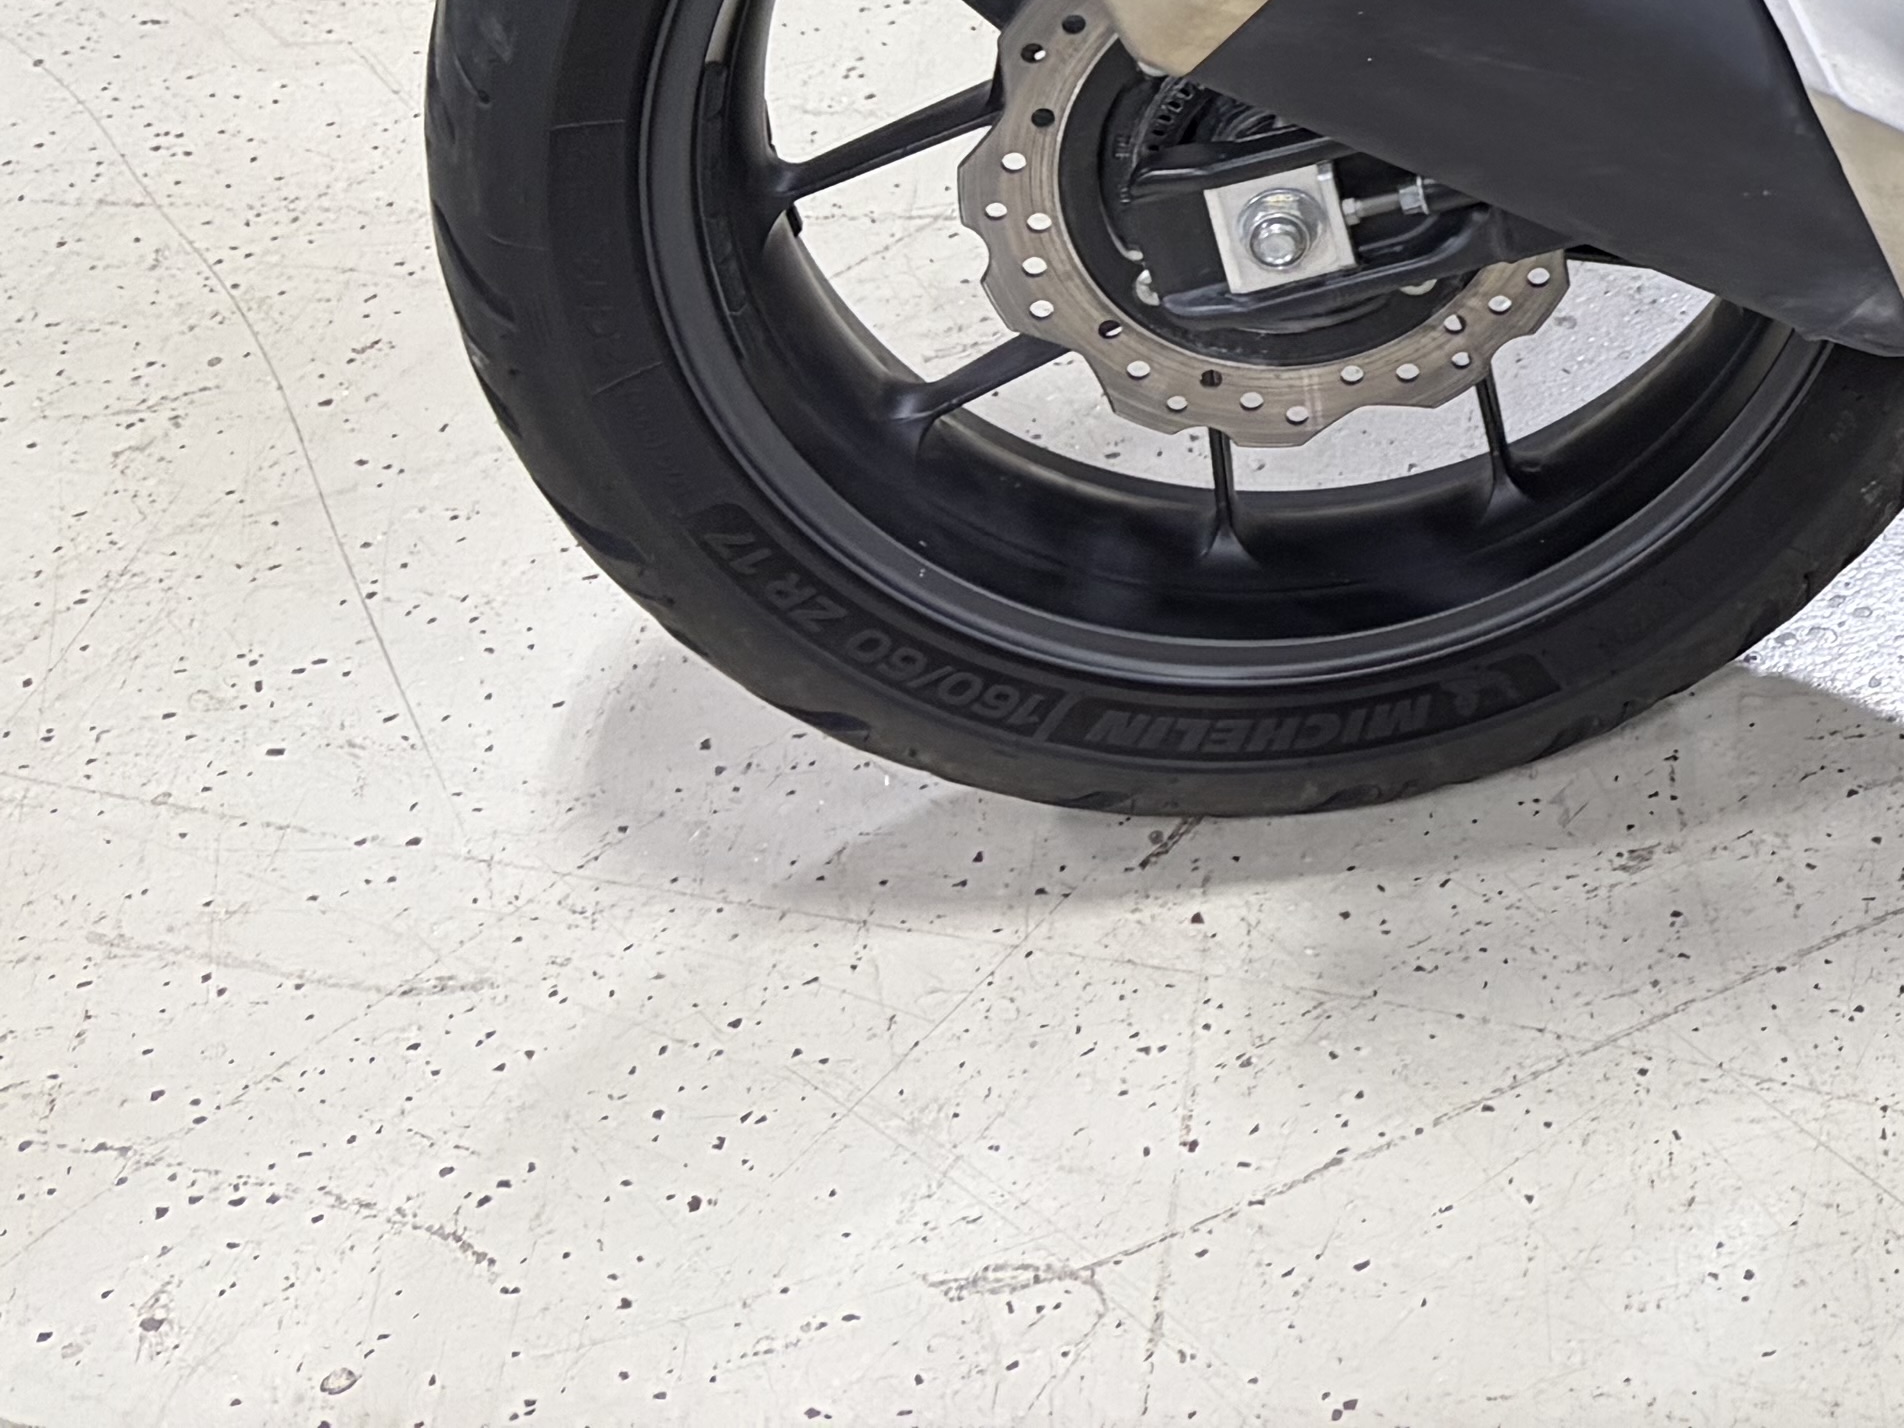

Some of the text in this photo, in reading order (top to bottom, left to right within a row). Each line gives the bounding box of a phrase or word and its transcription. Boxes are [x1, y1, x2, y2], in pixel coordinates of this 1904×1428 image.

[703, 528, 1432, 754] MICHELIN 160/60 ZR 17
